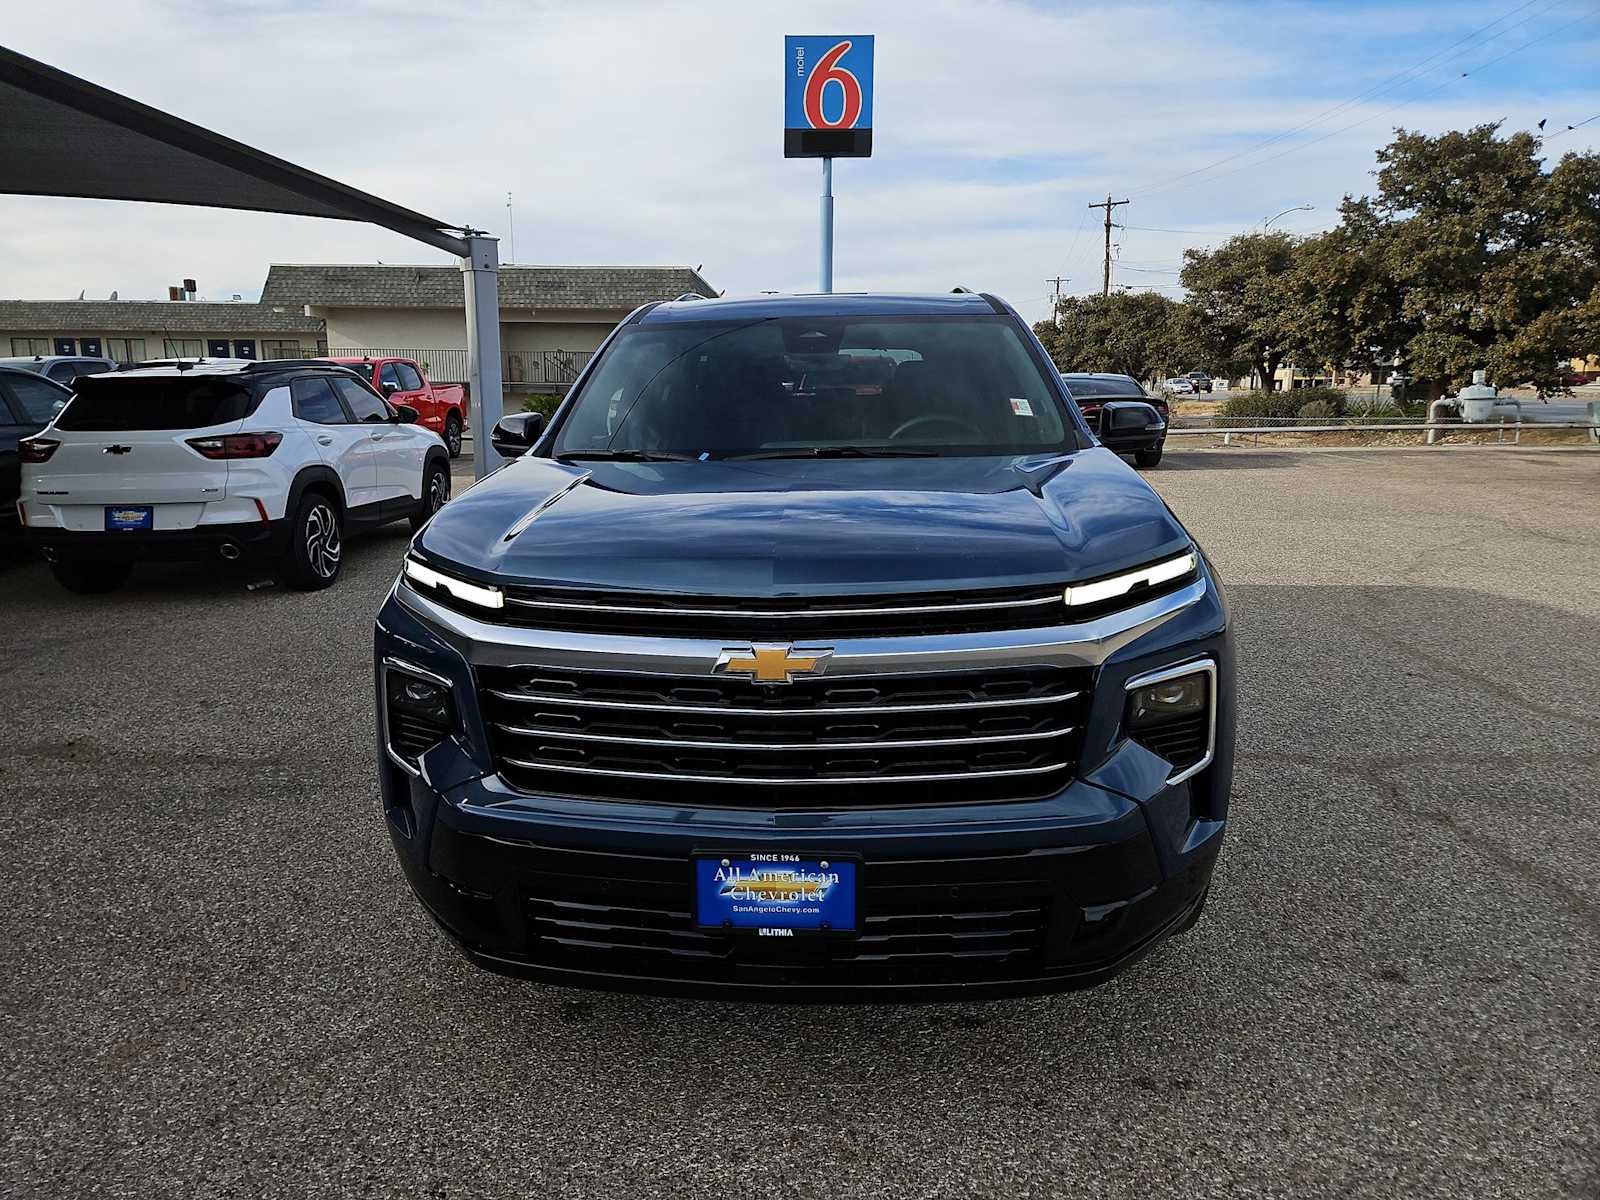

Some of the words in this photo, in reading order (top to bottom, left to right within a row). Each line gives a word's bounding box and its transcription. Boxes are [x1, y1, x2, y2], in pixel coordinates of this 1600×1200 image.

[795, 46, 805, 77] motel
[803, 40, 863, 129] 6
[750, 854, 778, 862] SINCE
[780, 854, 800, 862] 1946
[713, 867, 741, 882] All
[749, 868, 840, 884] American
[730, 886, 825, 902] Chevrolet
[732, 905, 820, 914] SanAngeloChevy.com
